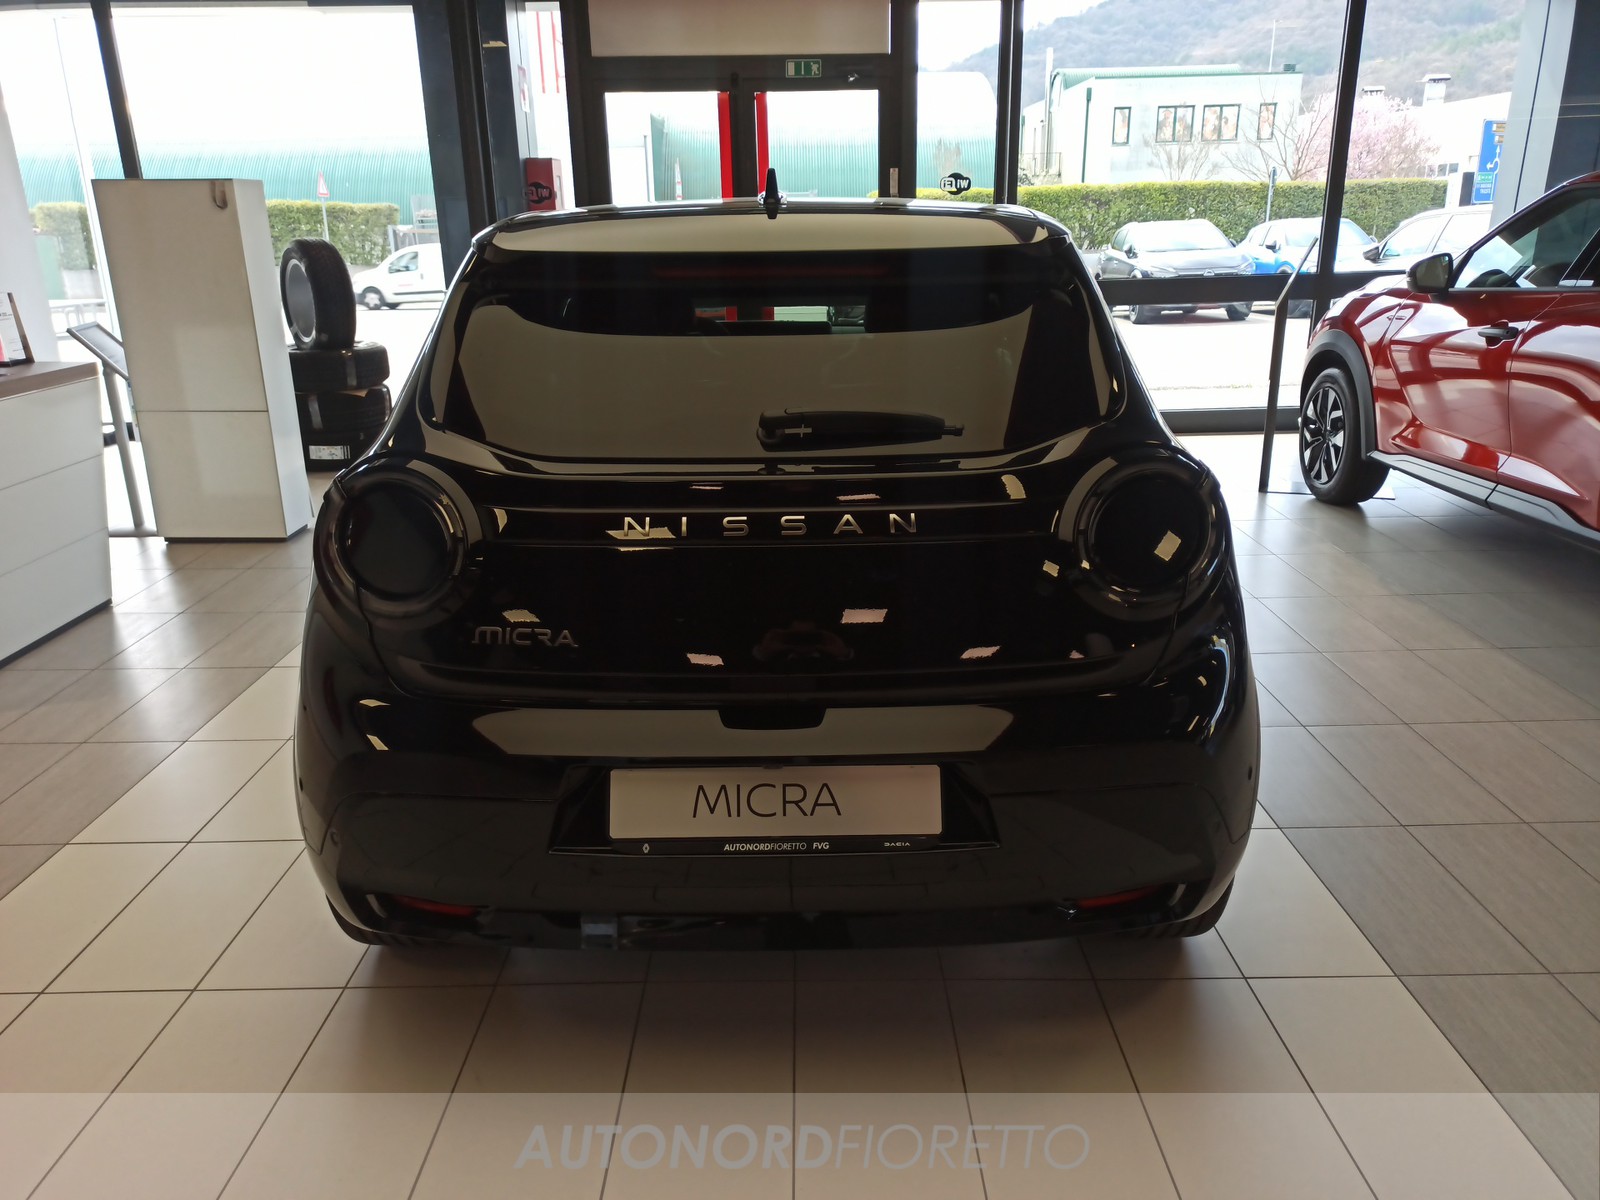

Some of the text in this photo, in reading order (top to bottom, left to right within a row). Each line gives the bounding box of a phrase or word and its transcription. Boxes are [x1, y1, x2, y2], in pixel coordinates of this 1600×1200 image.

[623, 512, 917, 537] NISSAN
[471, 626, 579, 647] MICRA
[692, 783, 842, 818] MICRA
[723, 841, 830, 851] AUTONORDFIORETTO FVG
